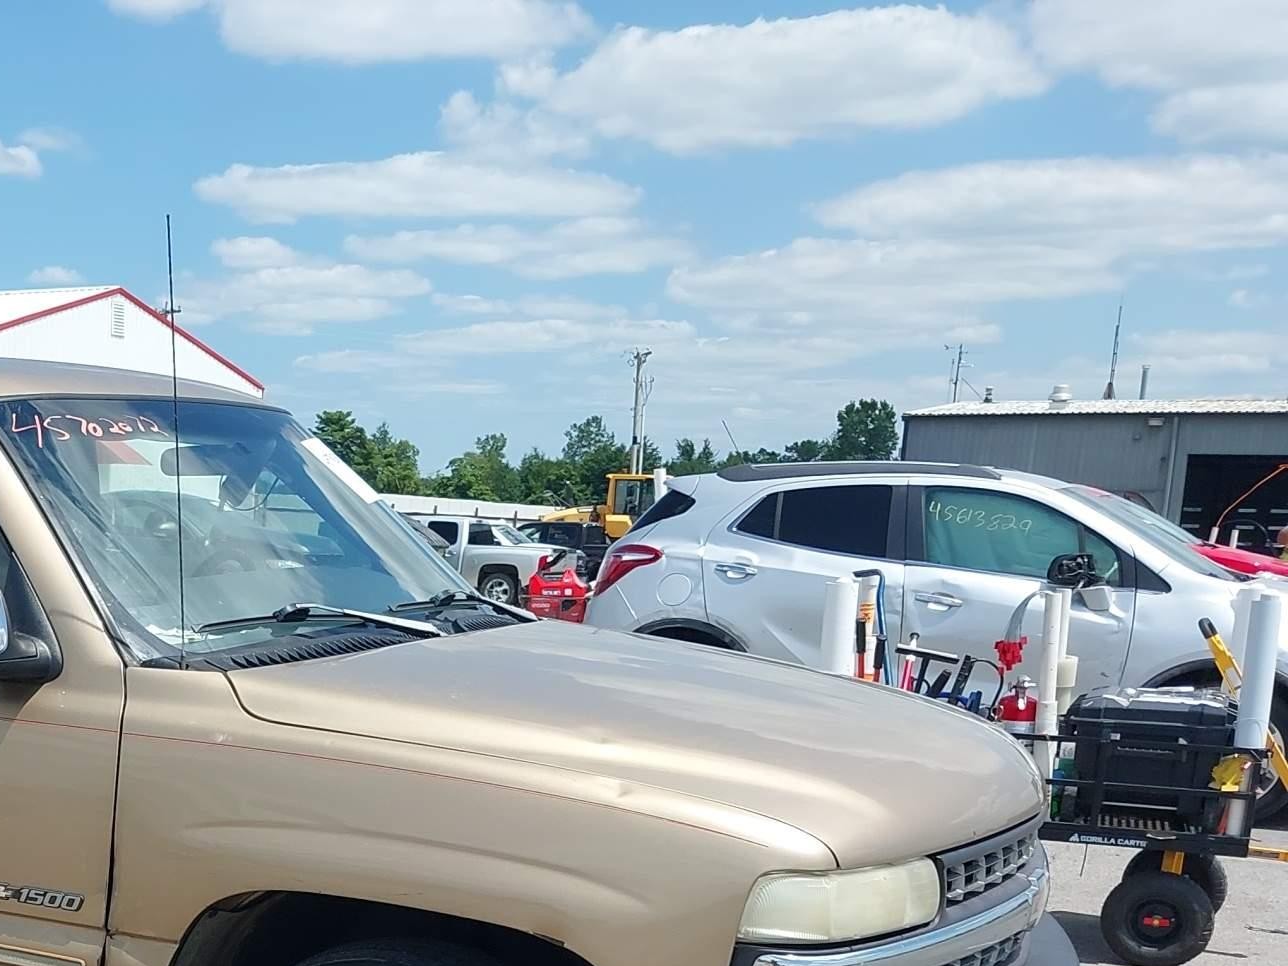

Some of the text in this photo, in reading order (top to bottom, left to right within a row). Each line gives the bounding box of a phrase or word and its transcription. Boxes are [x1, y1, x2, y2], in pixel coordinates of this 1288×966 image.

[929, 501, 1033, 536] 45613829
[1079, 834, 1116, 845] GORILLA
[18, 886, 83, 911] 1500
